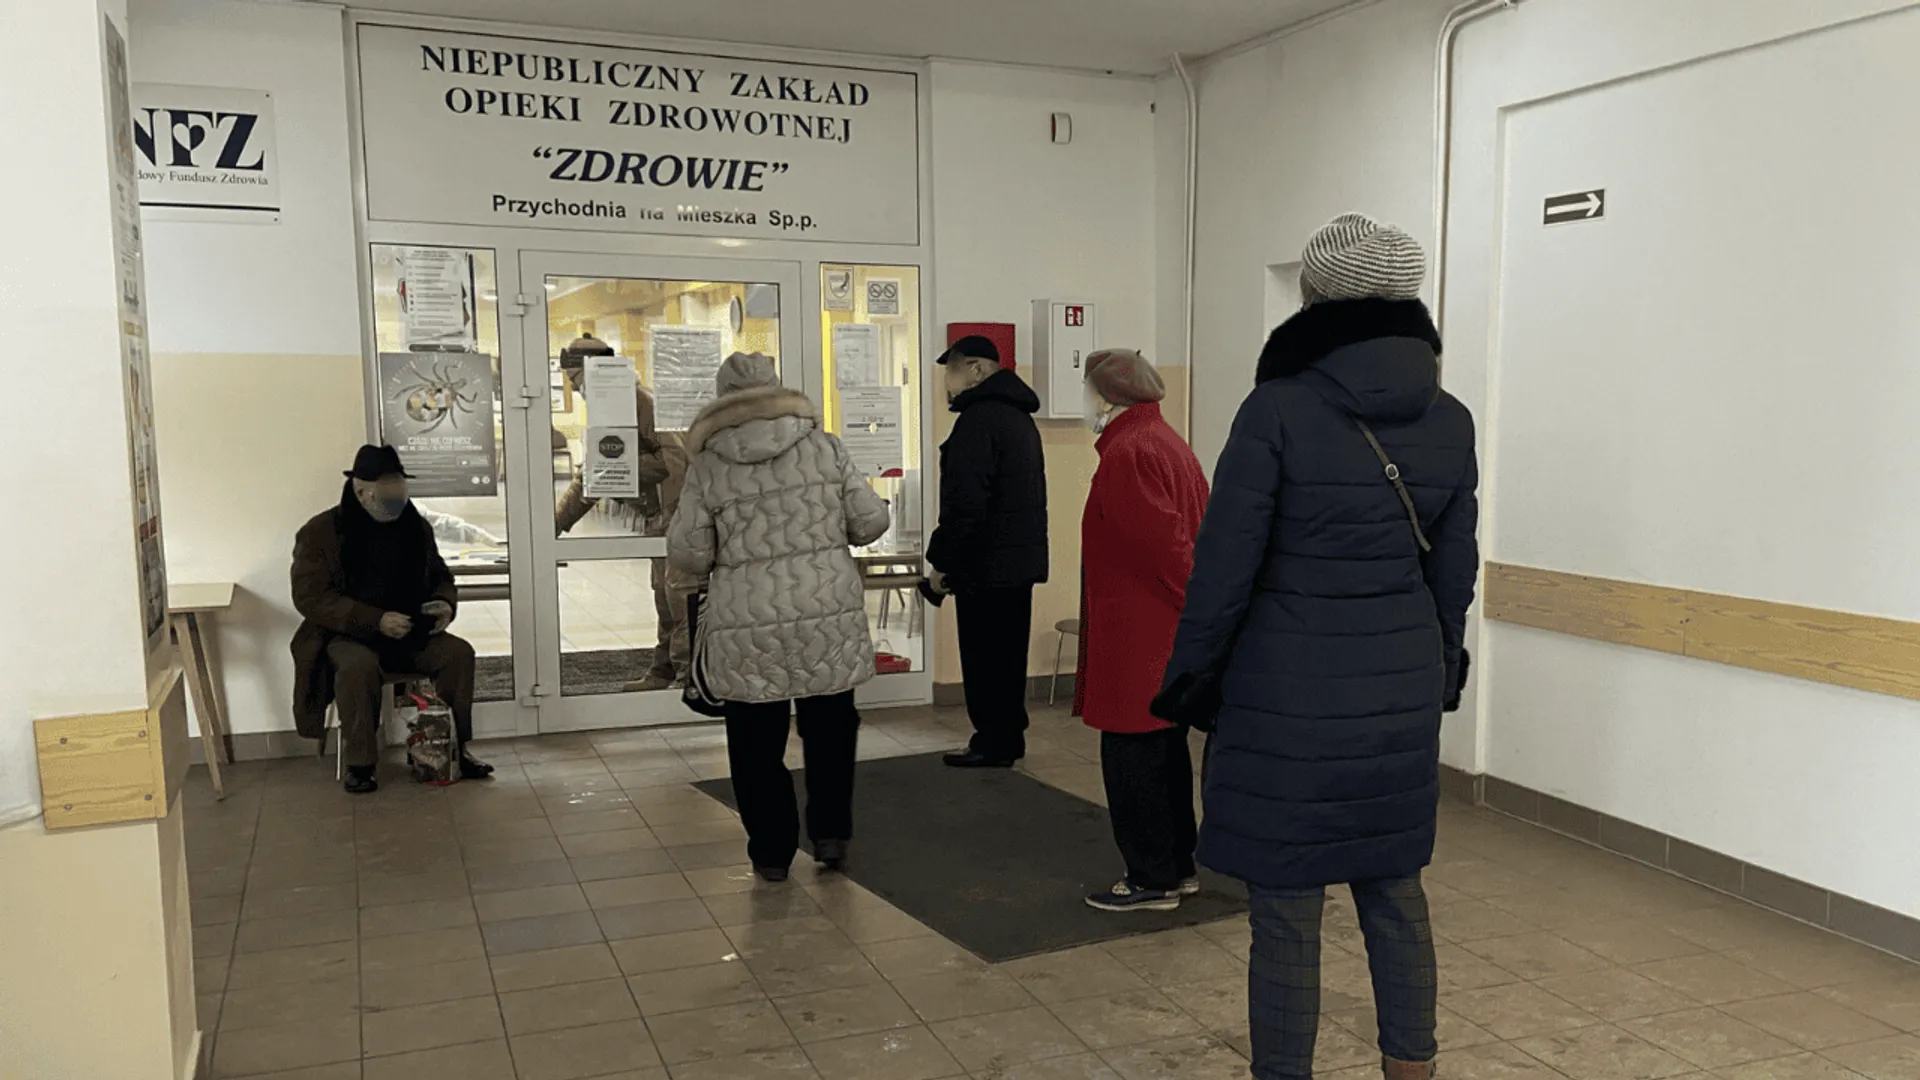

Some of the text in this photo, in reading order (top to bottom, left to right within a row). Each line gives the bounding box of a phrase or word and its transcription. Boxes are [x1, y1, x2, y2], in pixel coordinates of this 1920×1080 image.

[419, 44, 870, 106] NIEPUBLICZNY ZAKŁAD
[134, 107, 264, 171] NFZ
[444, 86, 852, 144] OPIEKI ZDROWOTNEJ
[169, 171, 218, 184] Fundusz
[220, 173, 269, 186] Zdrowia
[492, 194, 627, 219] Przychodnia
[676, 204, 758, 226] Mieszka
[768, 209, 819, 232] Sp.p.
